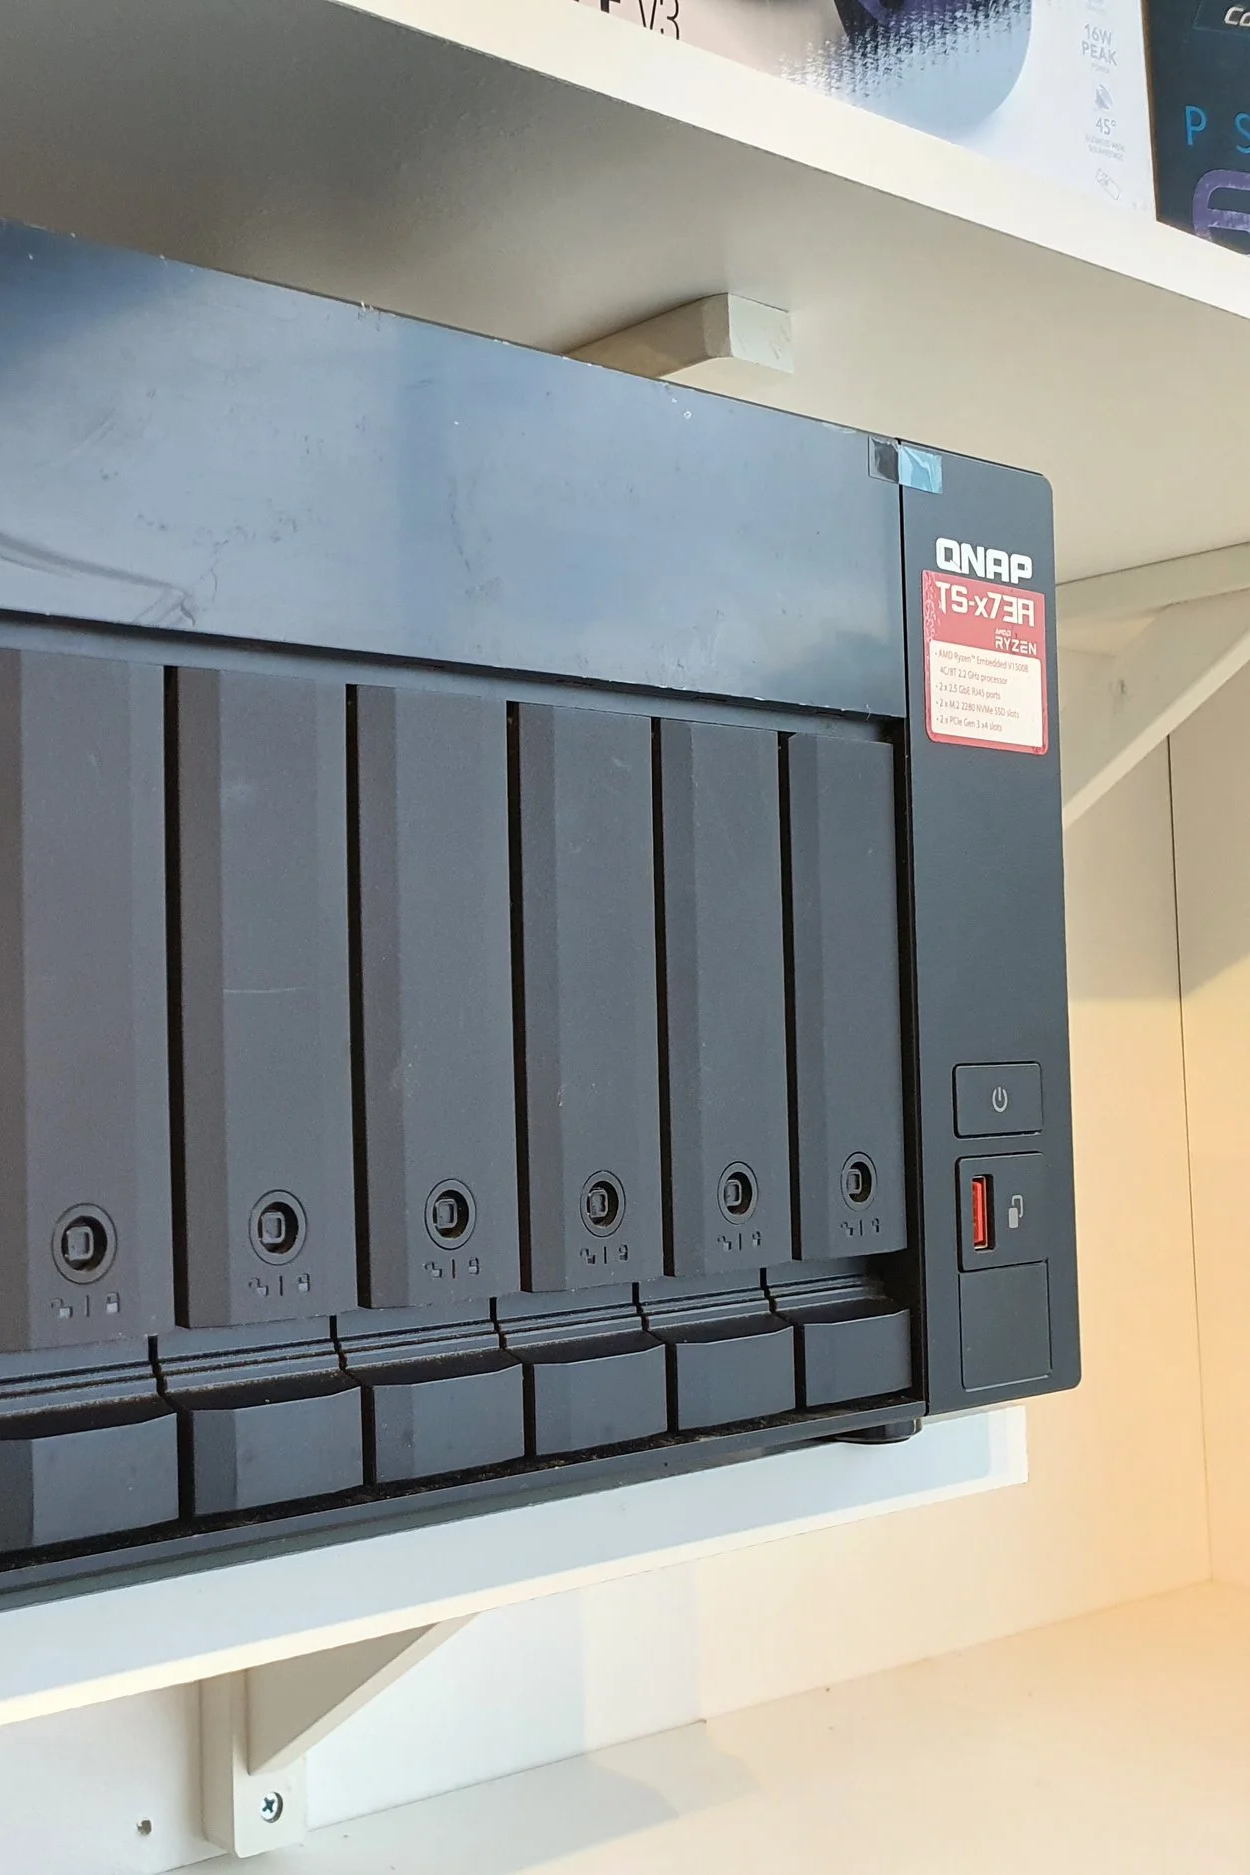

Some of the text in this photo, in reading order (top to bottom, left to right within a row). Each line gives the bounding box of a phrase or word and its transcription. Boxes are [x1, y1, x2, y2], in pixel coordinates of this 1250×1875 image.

[1084, 24, 1112, 46] 16W
[1081, 40, 1118, 67] PEAK
[935, 537, 1033, 585] QNAP
[935, 580, 1035, 627] TS-x73A
[995, 636, 1037, 655] RYZEN
[938, 649, 953, 660] AMD
[976, 656, 1007, 669] Embedded
[981, 674, 1008, 685] processor
